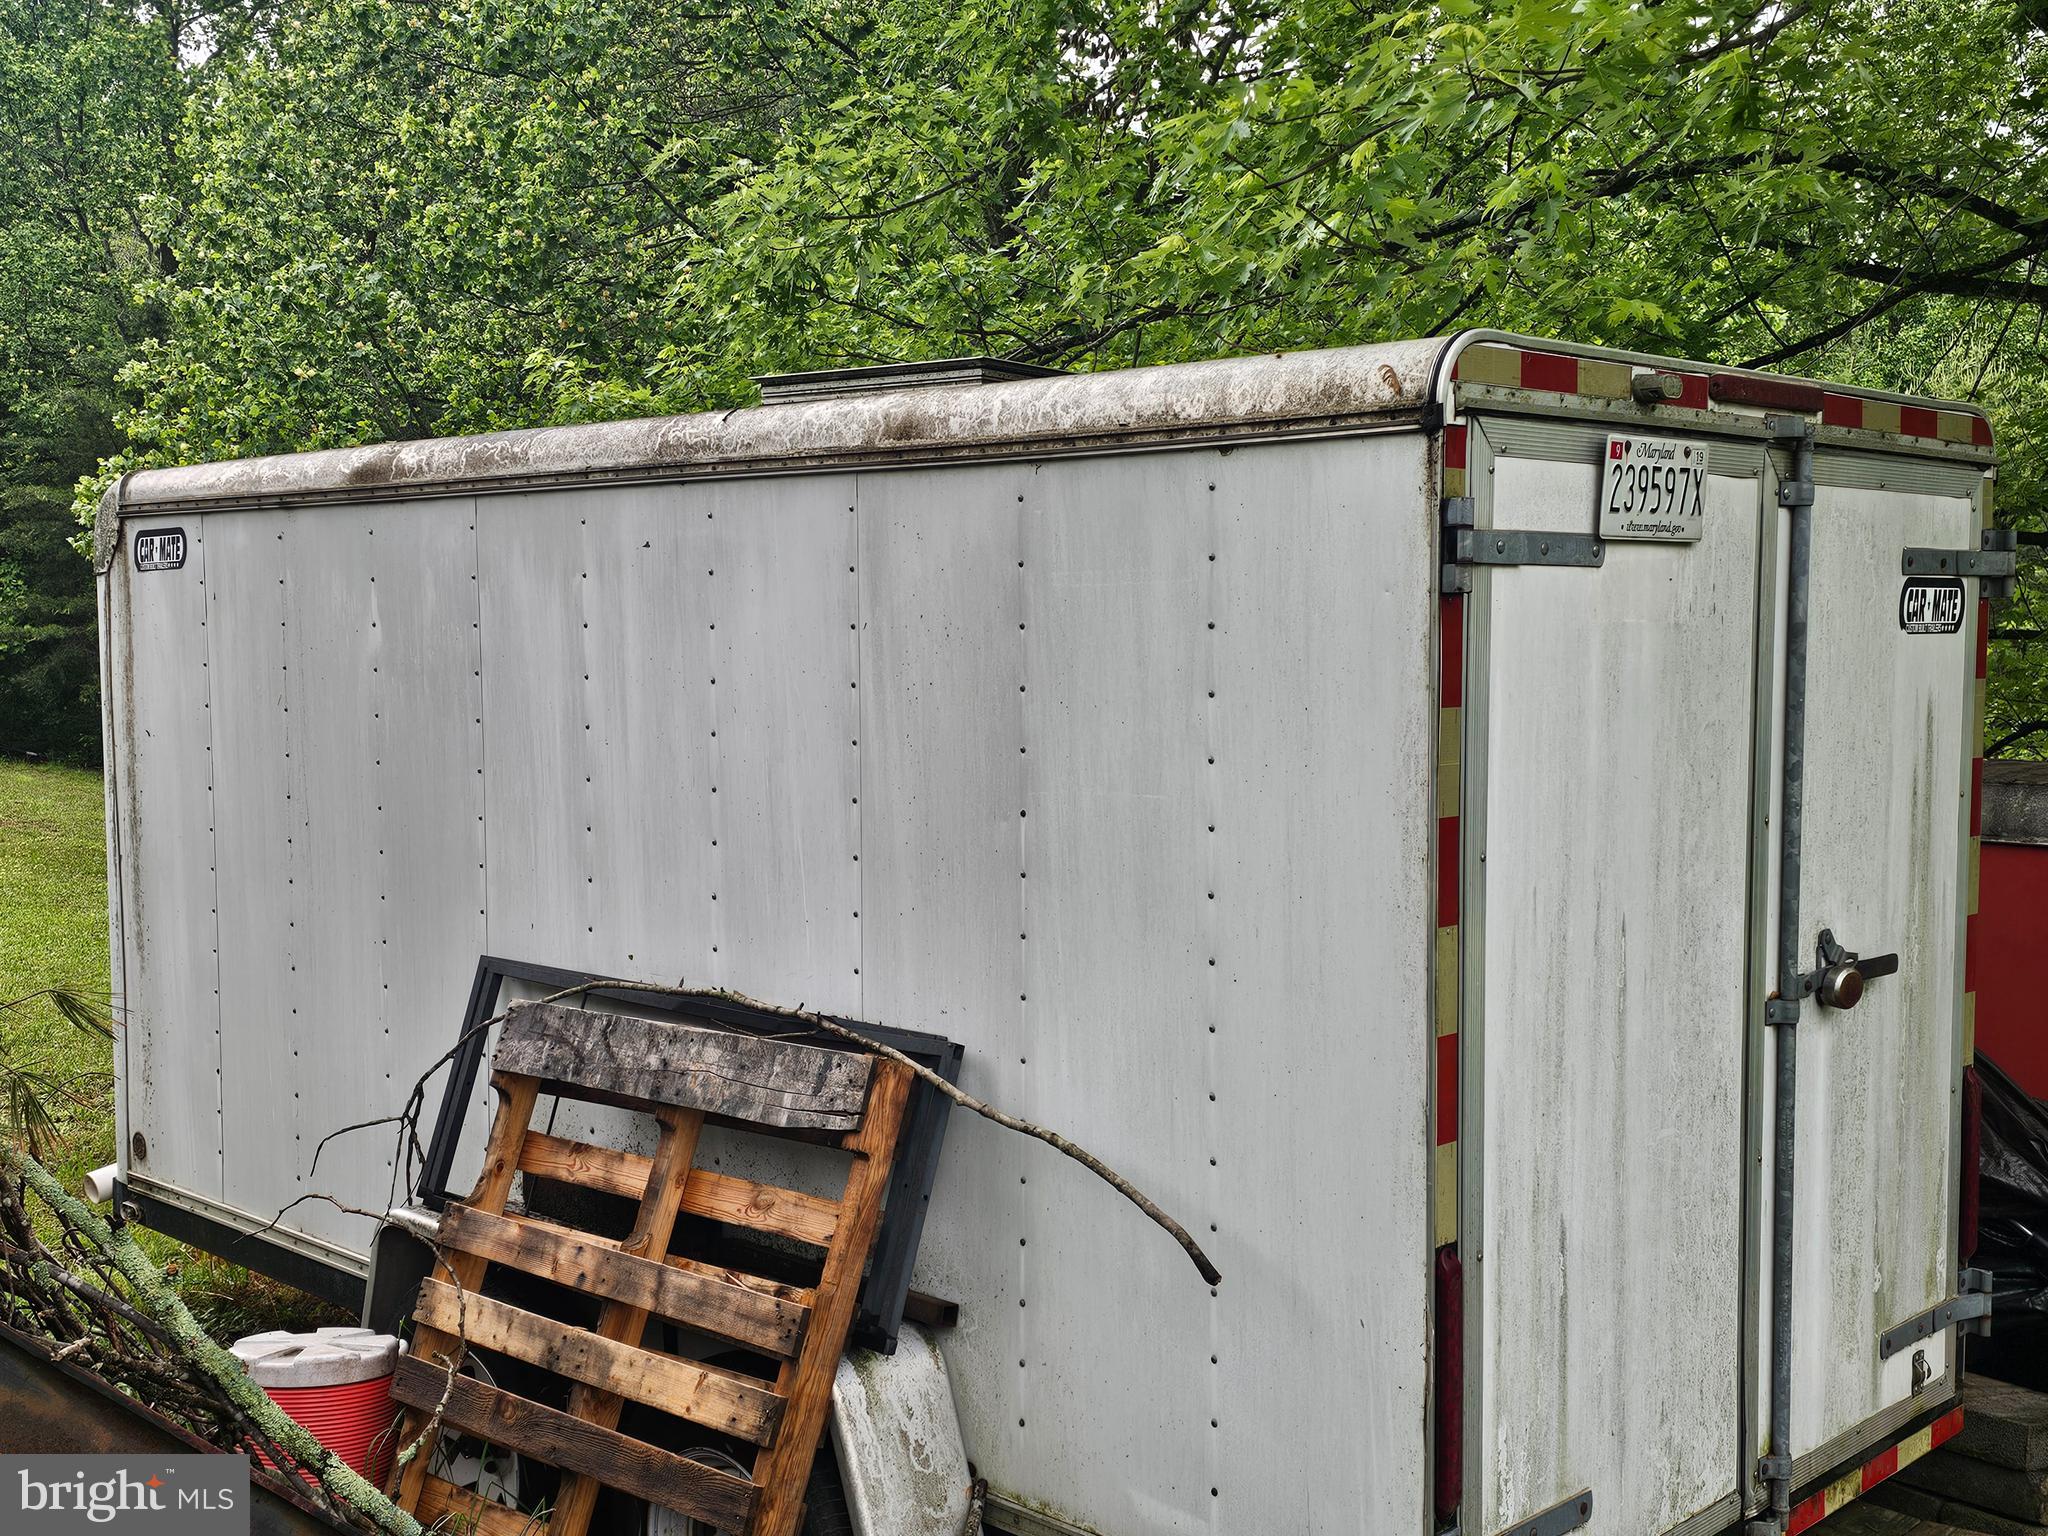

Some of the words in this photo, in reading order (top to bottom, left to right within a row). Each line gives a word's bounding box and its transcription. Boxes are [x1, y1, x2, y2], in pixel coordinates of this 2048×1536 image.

[1636, 443, 1677, 464] Maryland
[1695, 451, 1704, 462] 19
[1609, 463, 1704, 517] 239597X
